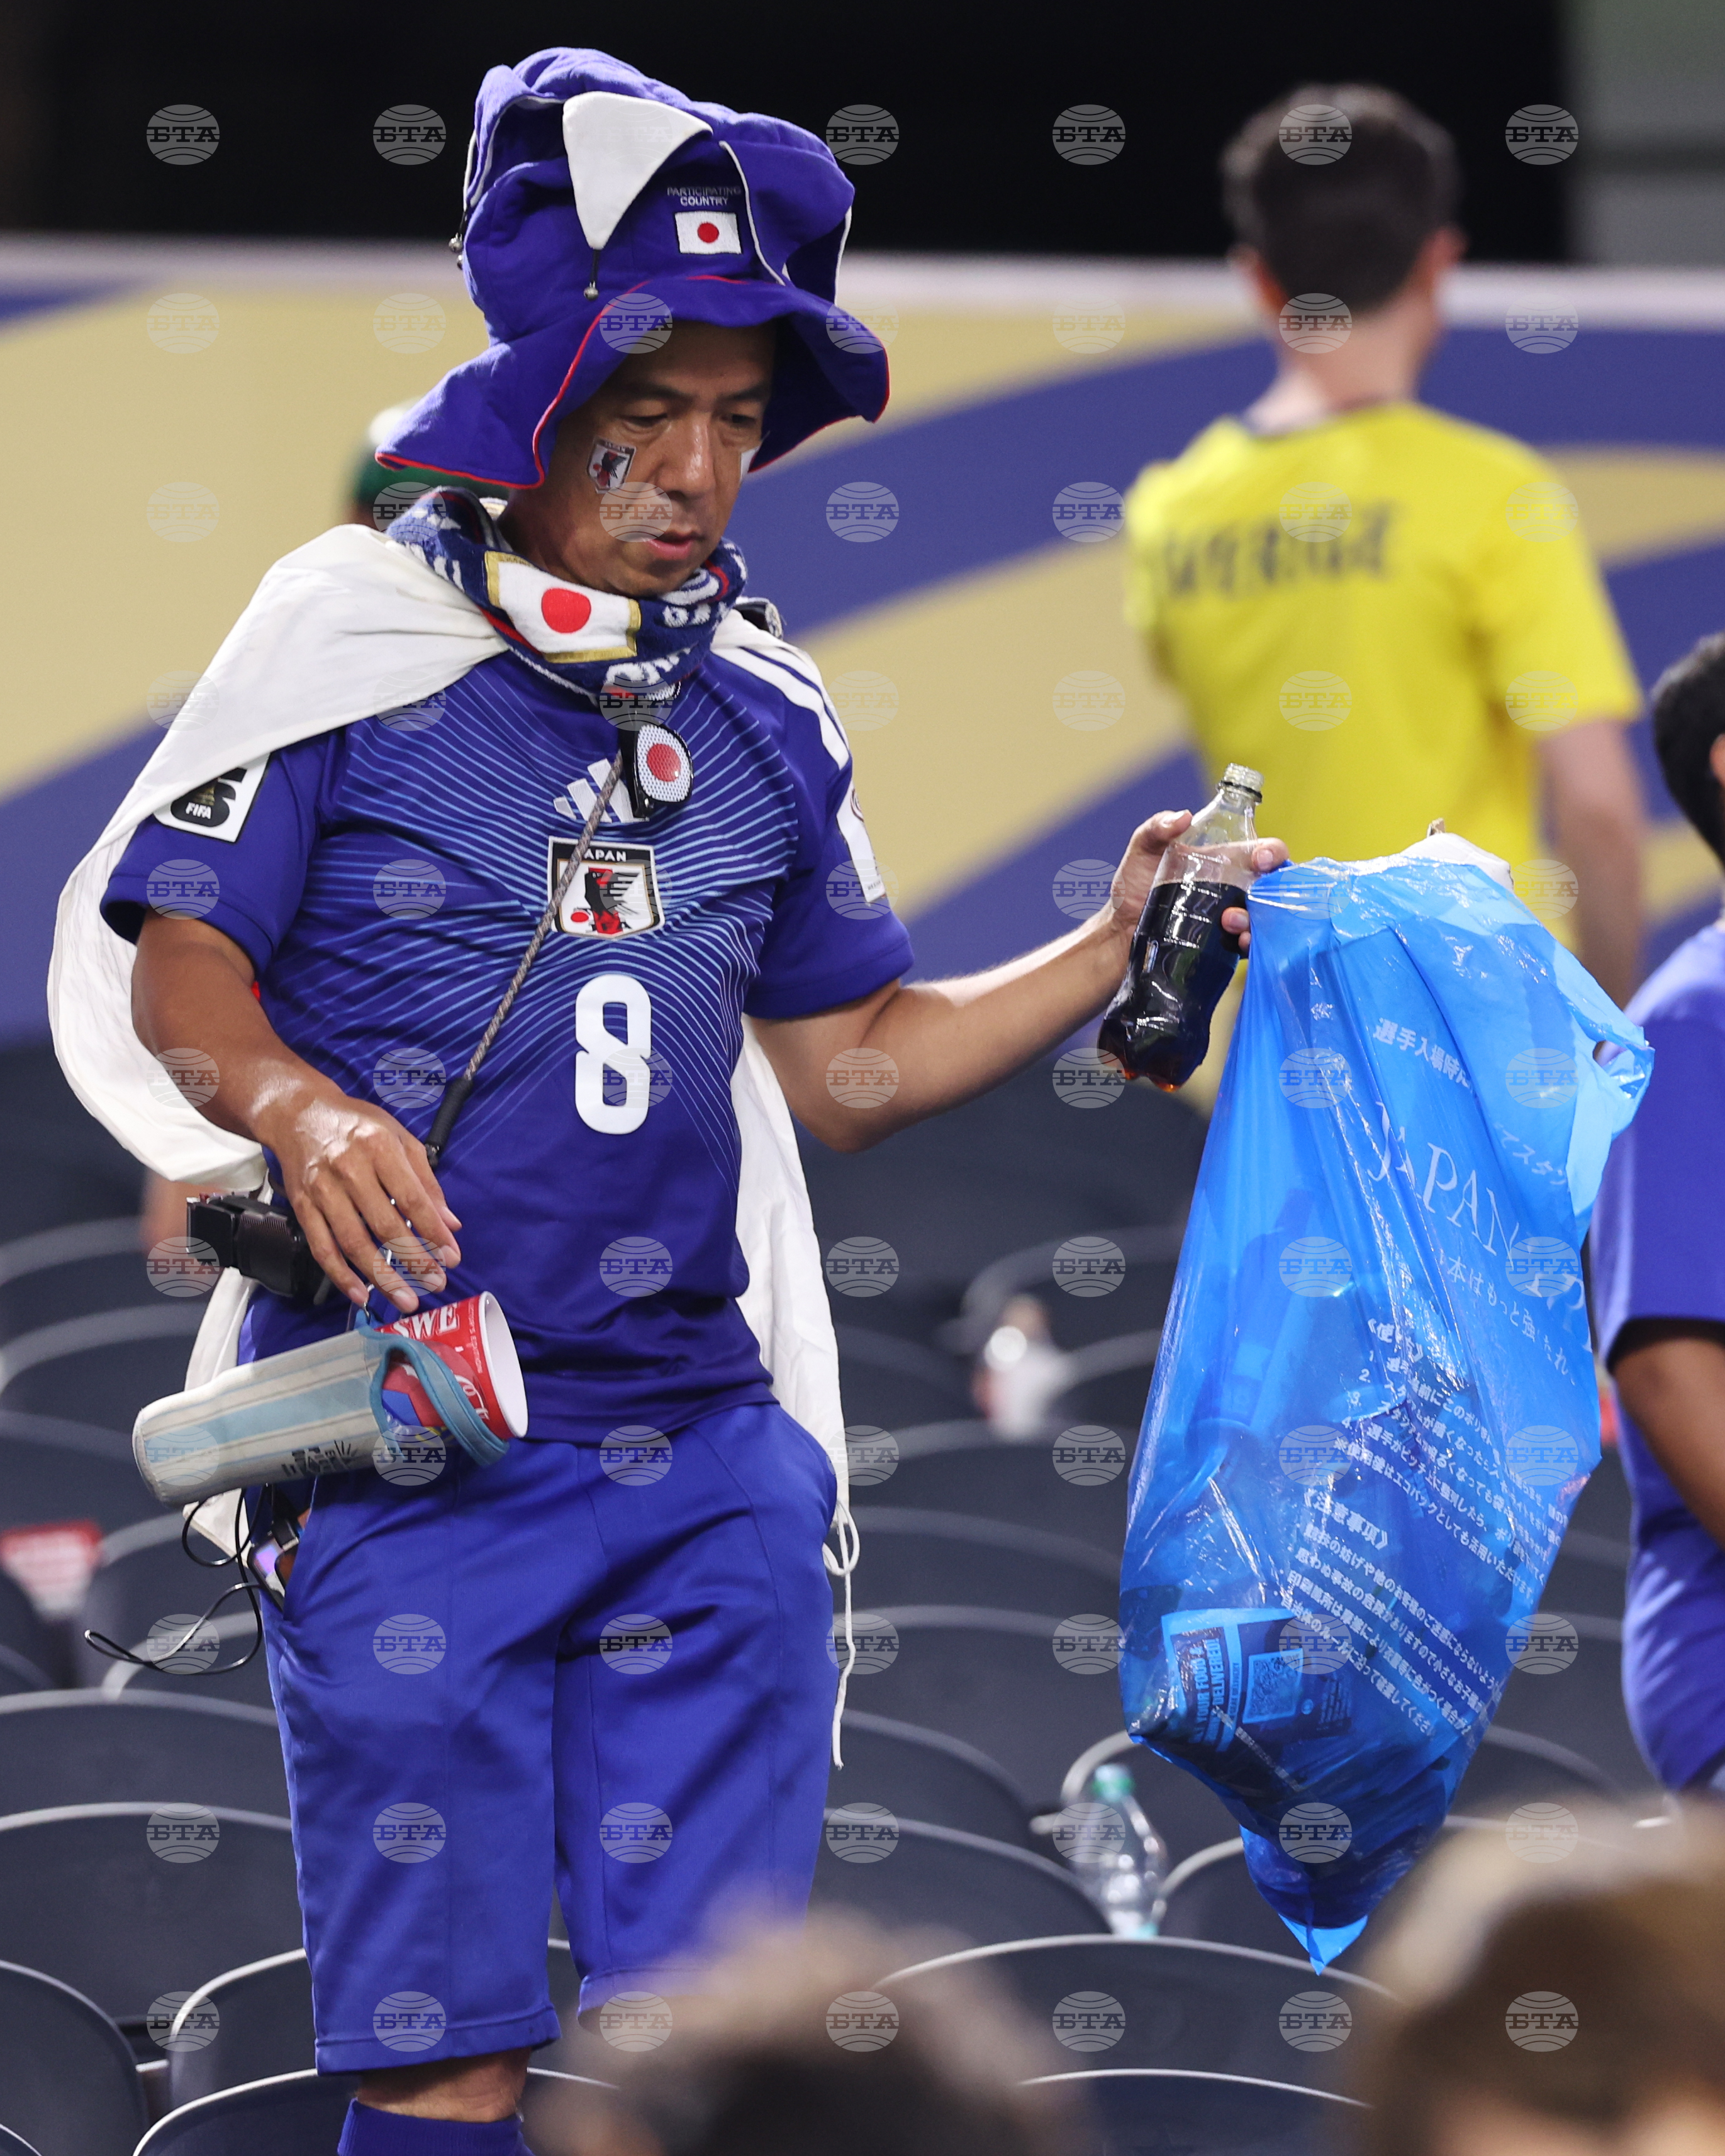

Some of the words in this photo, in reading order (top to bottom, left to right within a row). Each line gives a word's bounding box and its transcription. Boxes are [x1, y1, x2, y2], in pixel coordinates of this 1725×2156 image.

[667, 186, 741, 197] PARTICIPATING
[680, 196, 729, 206] COUNTRY
[185, 802, 212, 820] FIFA
[583, 848, 627, 862] APAN
[575, 974, 652, 1135] 8
[1368, 1101, 1519, 1269] JAPAN
[391, 1302, 460, 1340] SWE
[1190, 1657, 1209, 1691] FOOD
[1204, 1637, 1225, 1706] DELIVERED!
